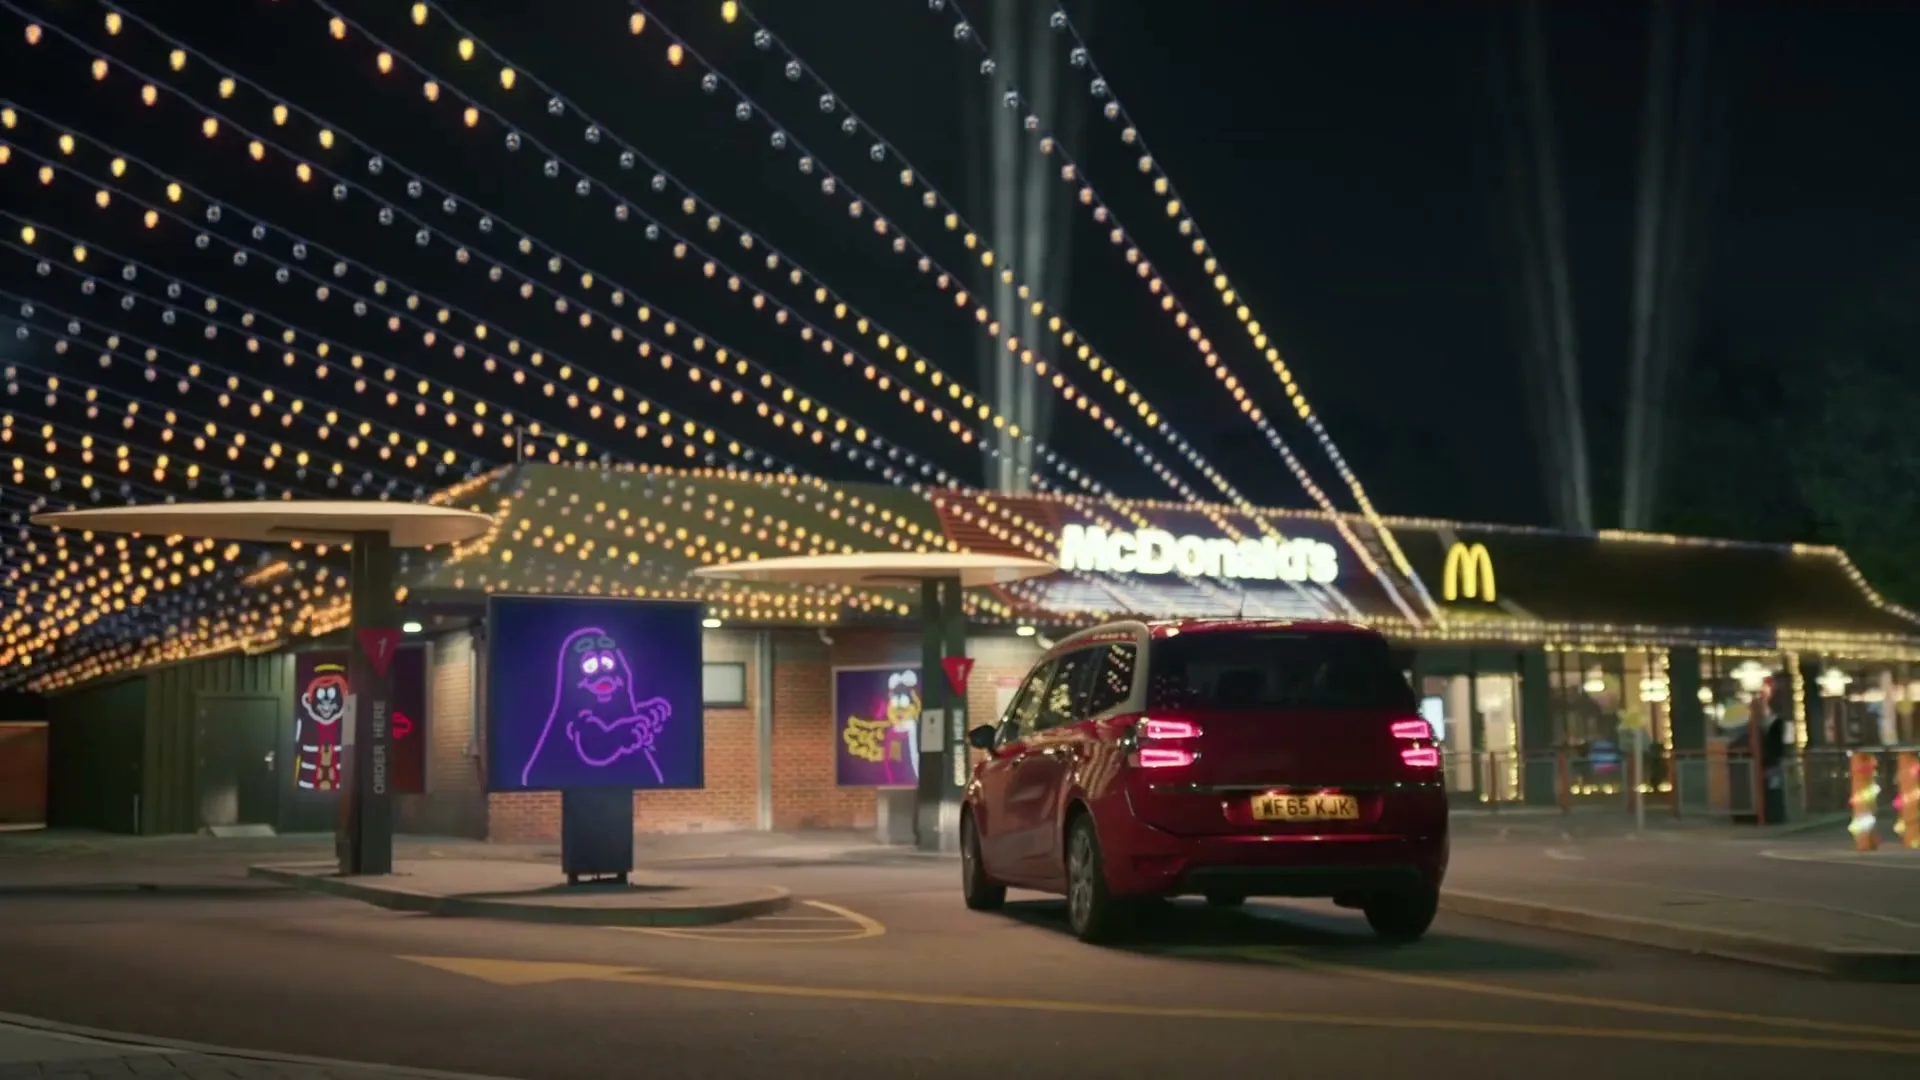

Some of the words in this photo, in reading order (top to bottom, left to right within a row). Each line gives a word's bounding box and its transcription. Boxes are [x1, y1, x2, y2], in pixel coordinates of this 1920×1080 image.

[1060, 524, 1338, 583] McDonald's
[377, 637, 387, 657] 1
[374, 700, 386, 738] HERE
[373, 745, 386, 794] ORDER
[1262, 798, 1310, 816] WF65
[1315, 798, 1350, 815] KJK
